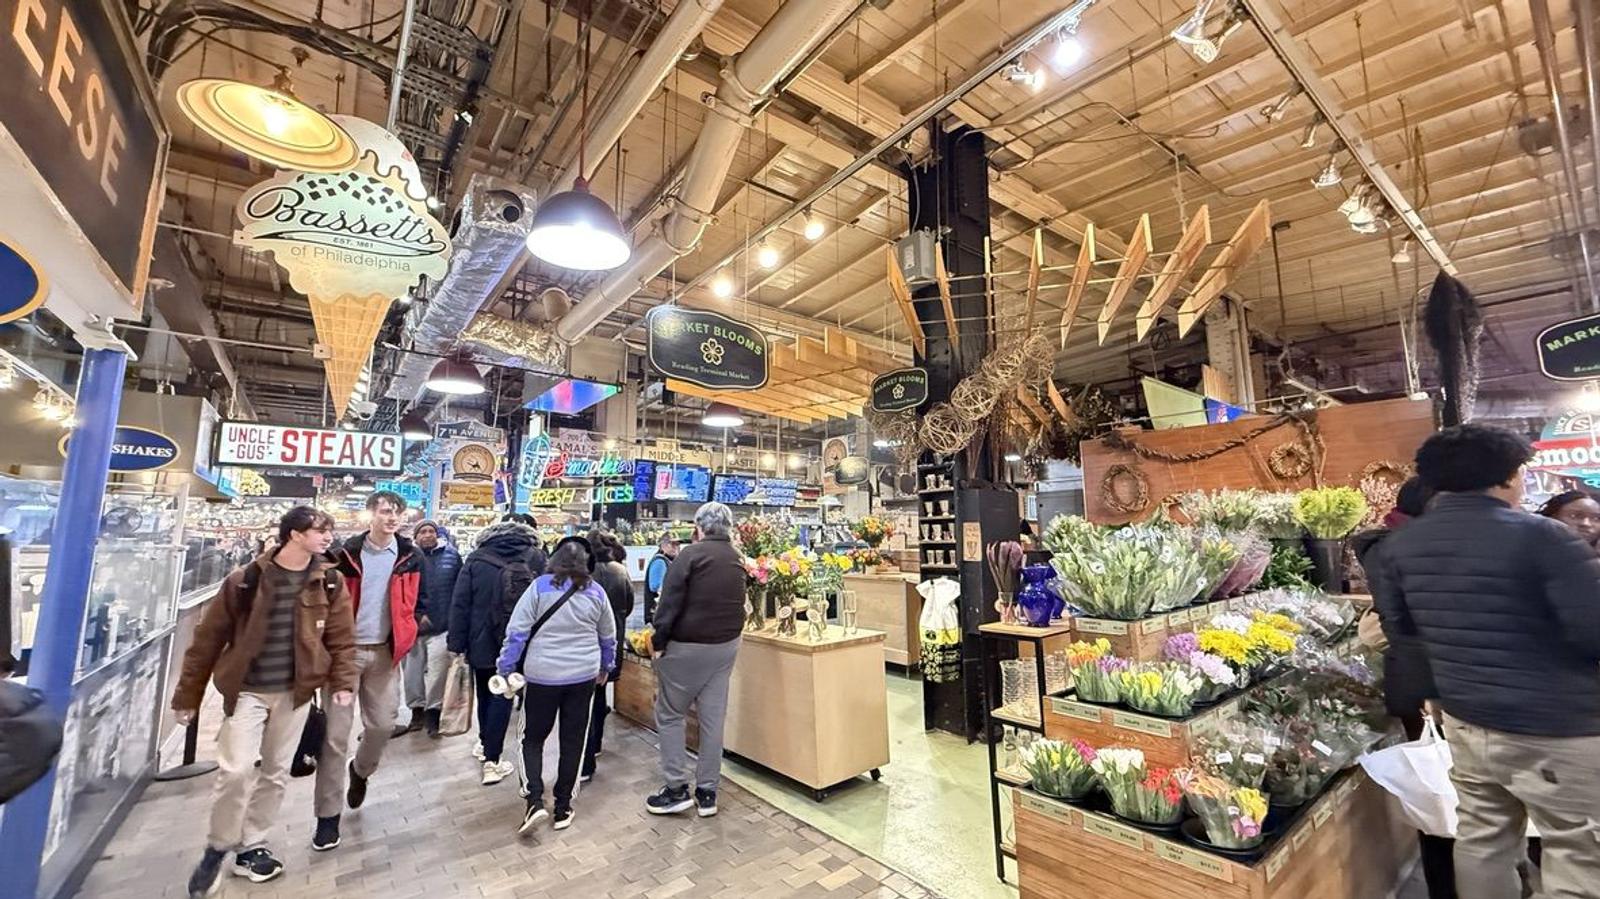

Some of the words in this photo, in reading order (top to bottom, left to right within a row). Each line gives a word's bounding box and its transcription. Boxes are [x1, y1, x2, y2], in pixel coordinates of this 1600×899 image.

[247, 186, 437, 246] Bassetts
[332, 237, 354, 246] EST.
[356, 240, 374, 249] 1861
[290, 244, 307, 256] of
[313, 246, 411, 271] Philadelphia
[713, 326, 763, 355] BLOOMS
[1546, 326, 1600, 351] MARK
[700, 365, 728, 376] Terminal
[728, 370, 750, 380] Market
[874, 377, 898, 393] MARKET
[898, 375, 925, 385] BLOOMS
[111, 444, 173, 458] SHAKES
[228, 427, 276, 444] UNCLE
[280, 429, 396, 468] STEAKS
[379, 482, 421, 495] BEER
[528, 488, 575, 505] FRESH
